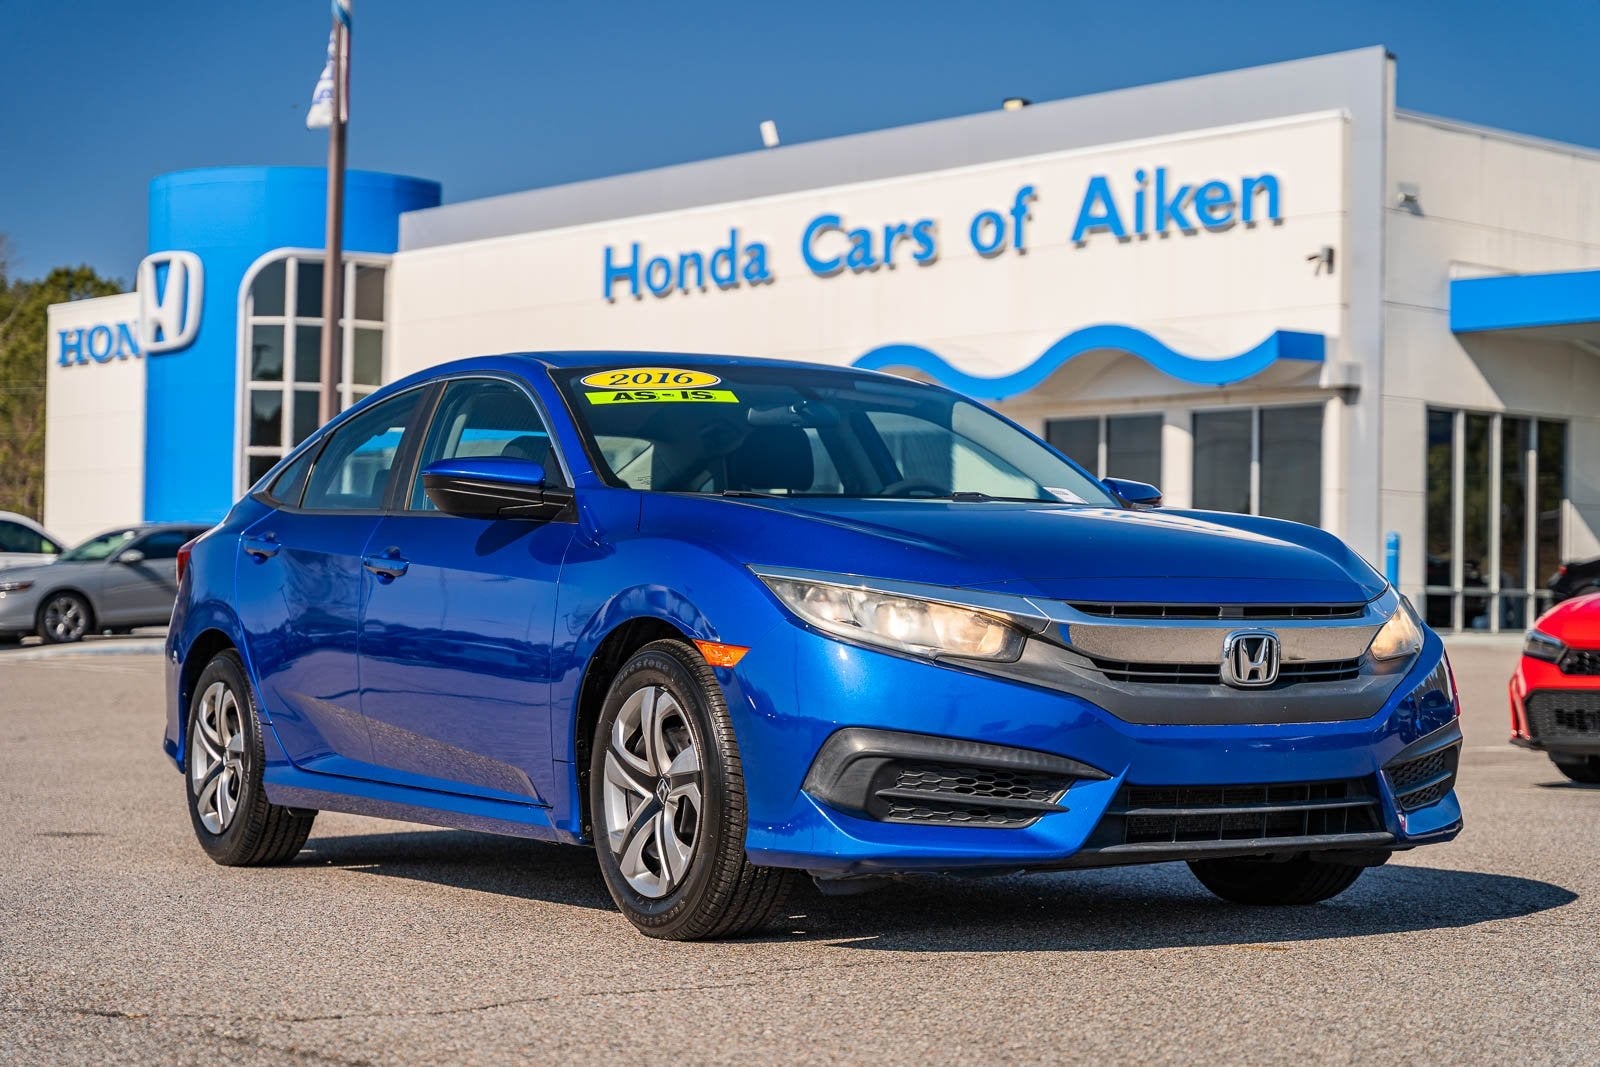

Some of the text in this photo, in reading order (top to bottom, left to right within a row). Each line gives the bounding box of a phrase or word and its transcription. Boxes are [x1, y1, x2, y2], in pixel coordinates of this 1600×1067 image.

[604, 167, 1279, 298] Honda Cars of Aiken
[609, 372, 694, 386] 2016
